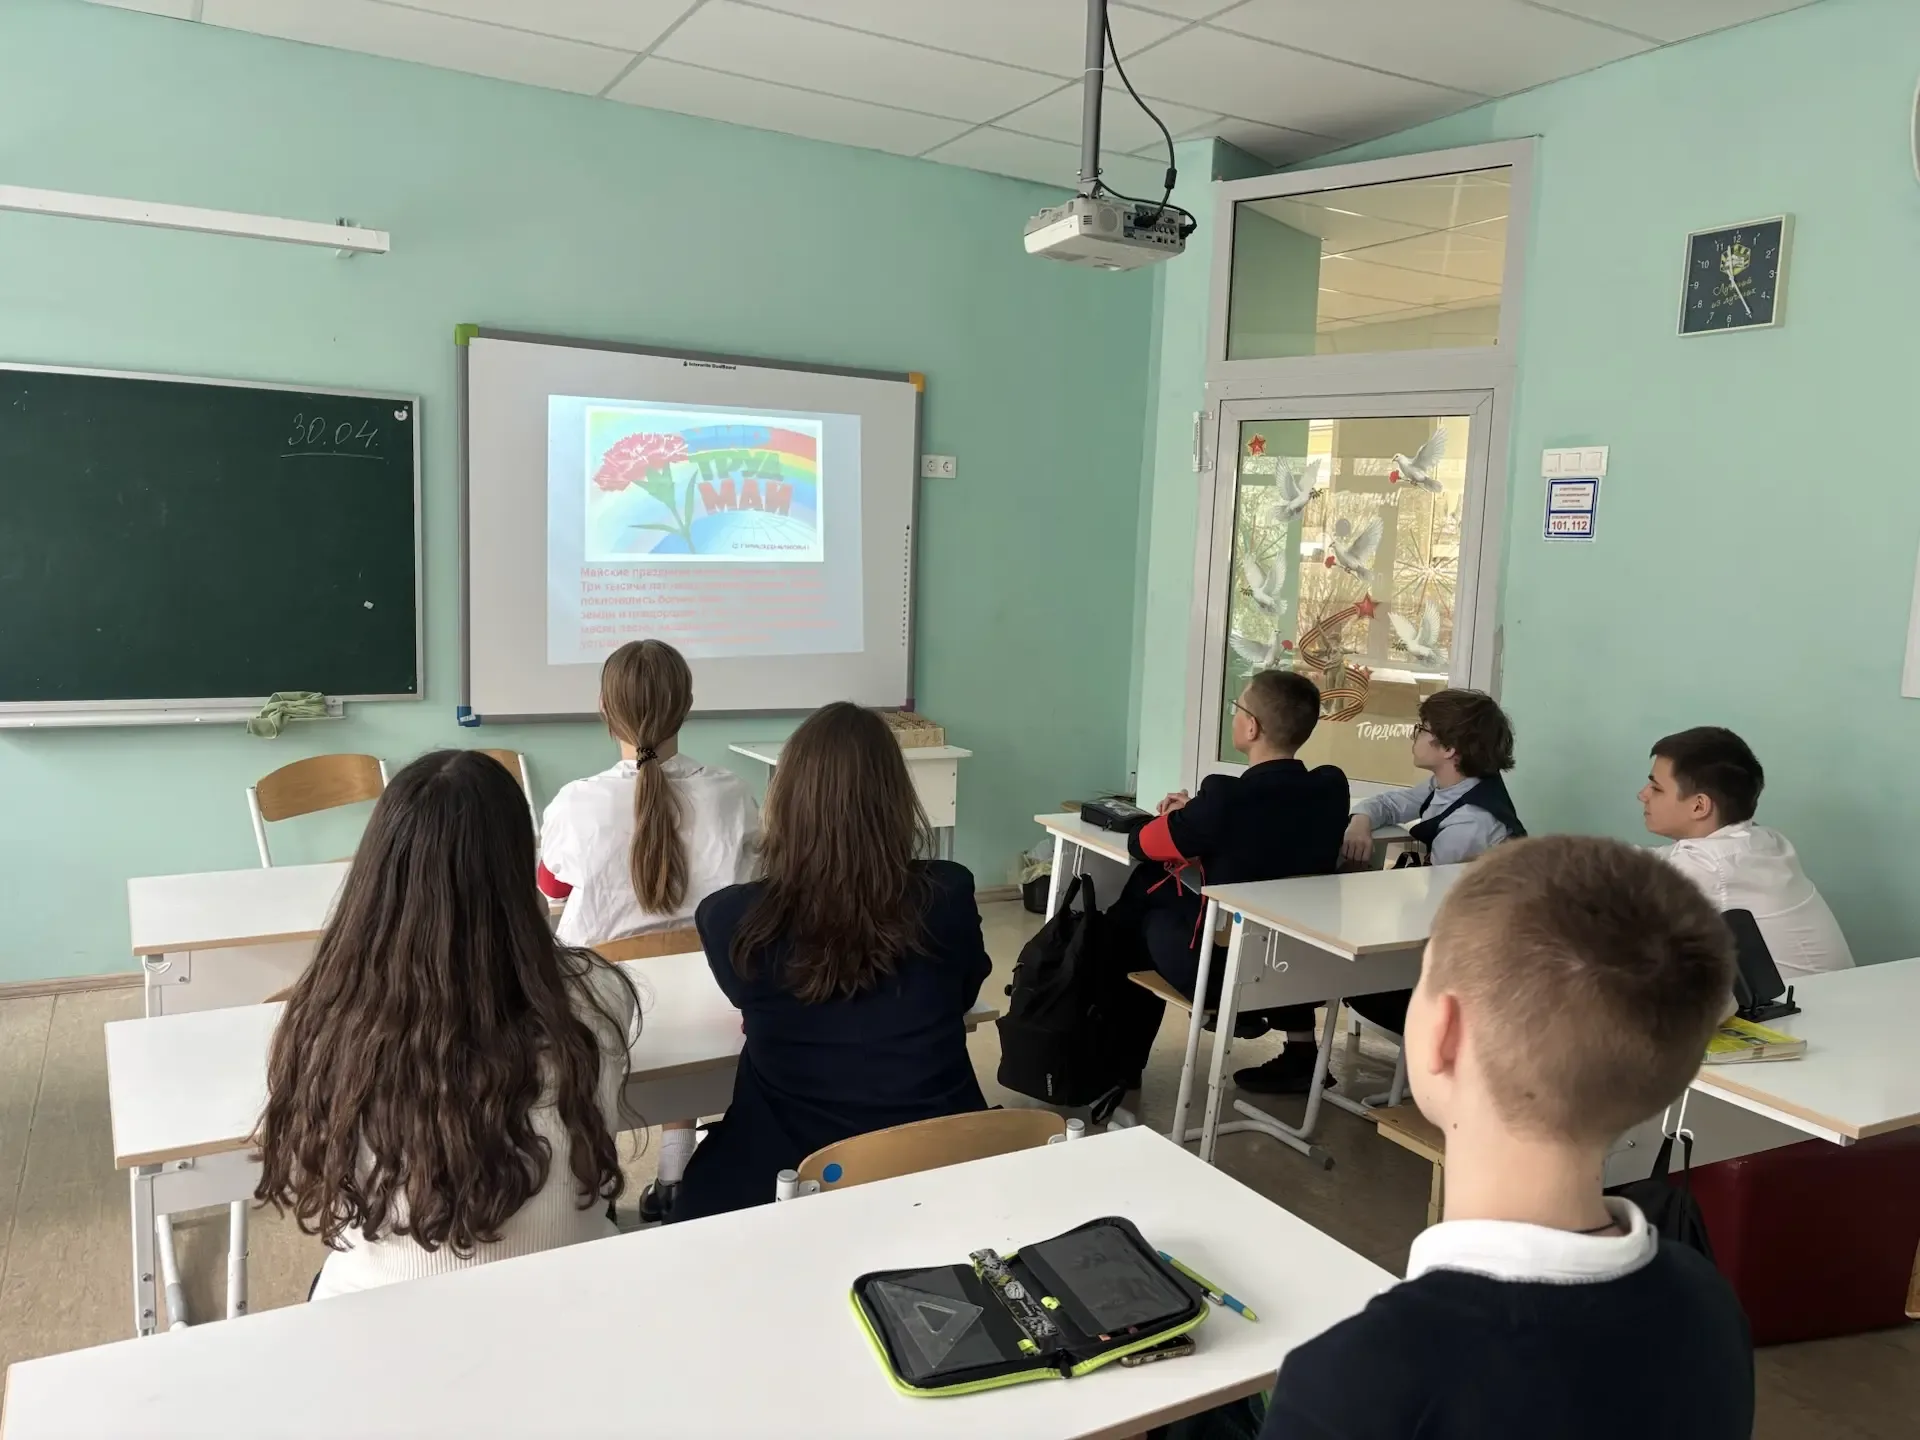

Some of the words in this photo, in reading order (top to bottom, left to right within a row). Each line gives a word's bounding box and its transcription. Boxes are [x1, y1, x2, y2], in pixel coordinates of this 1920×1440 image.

[1733, 234, 1742, 243] 12
[688, 449, 784, 481] ТРУД
[1552, 520, 1570, 531] 101,
[1571, 520, 1588, 531] 112
[580, 567, 629, 577] Майские
[580, 580, 601, 593] Три
[605, 582, 646, 592] тысячи
